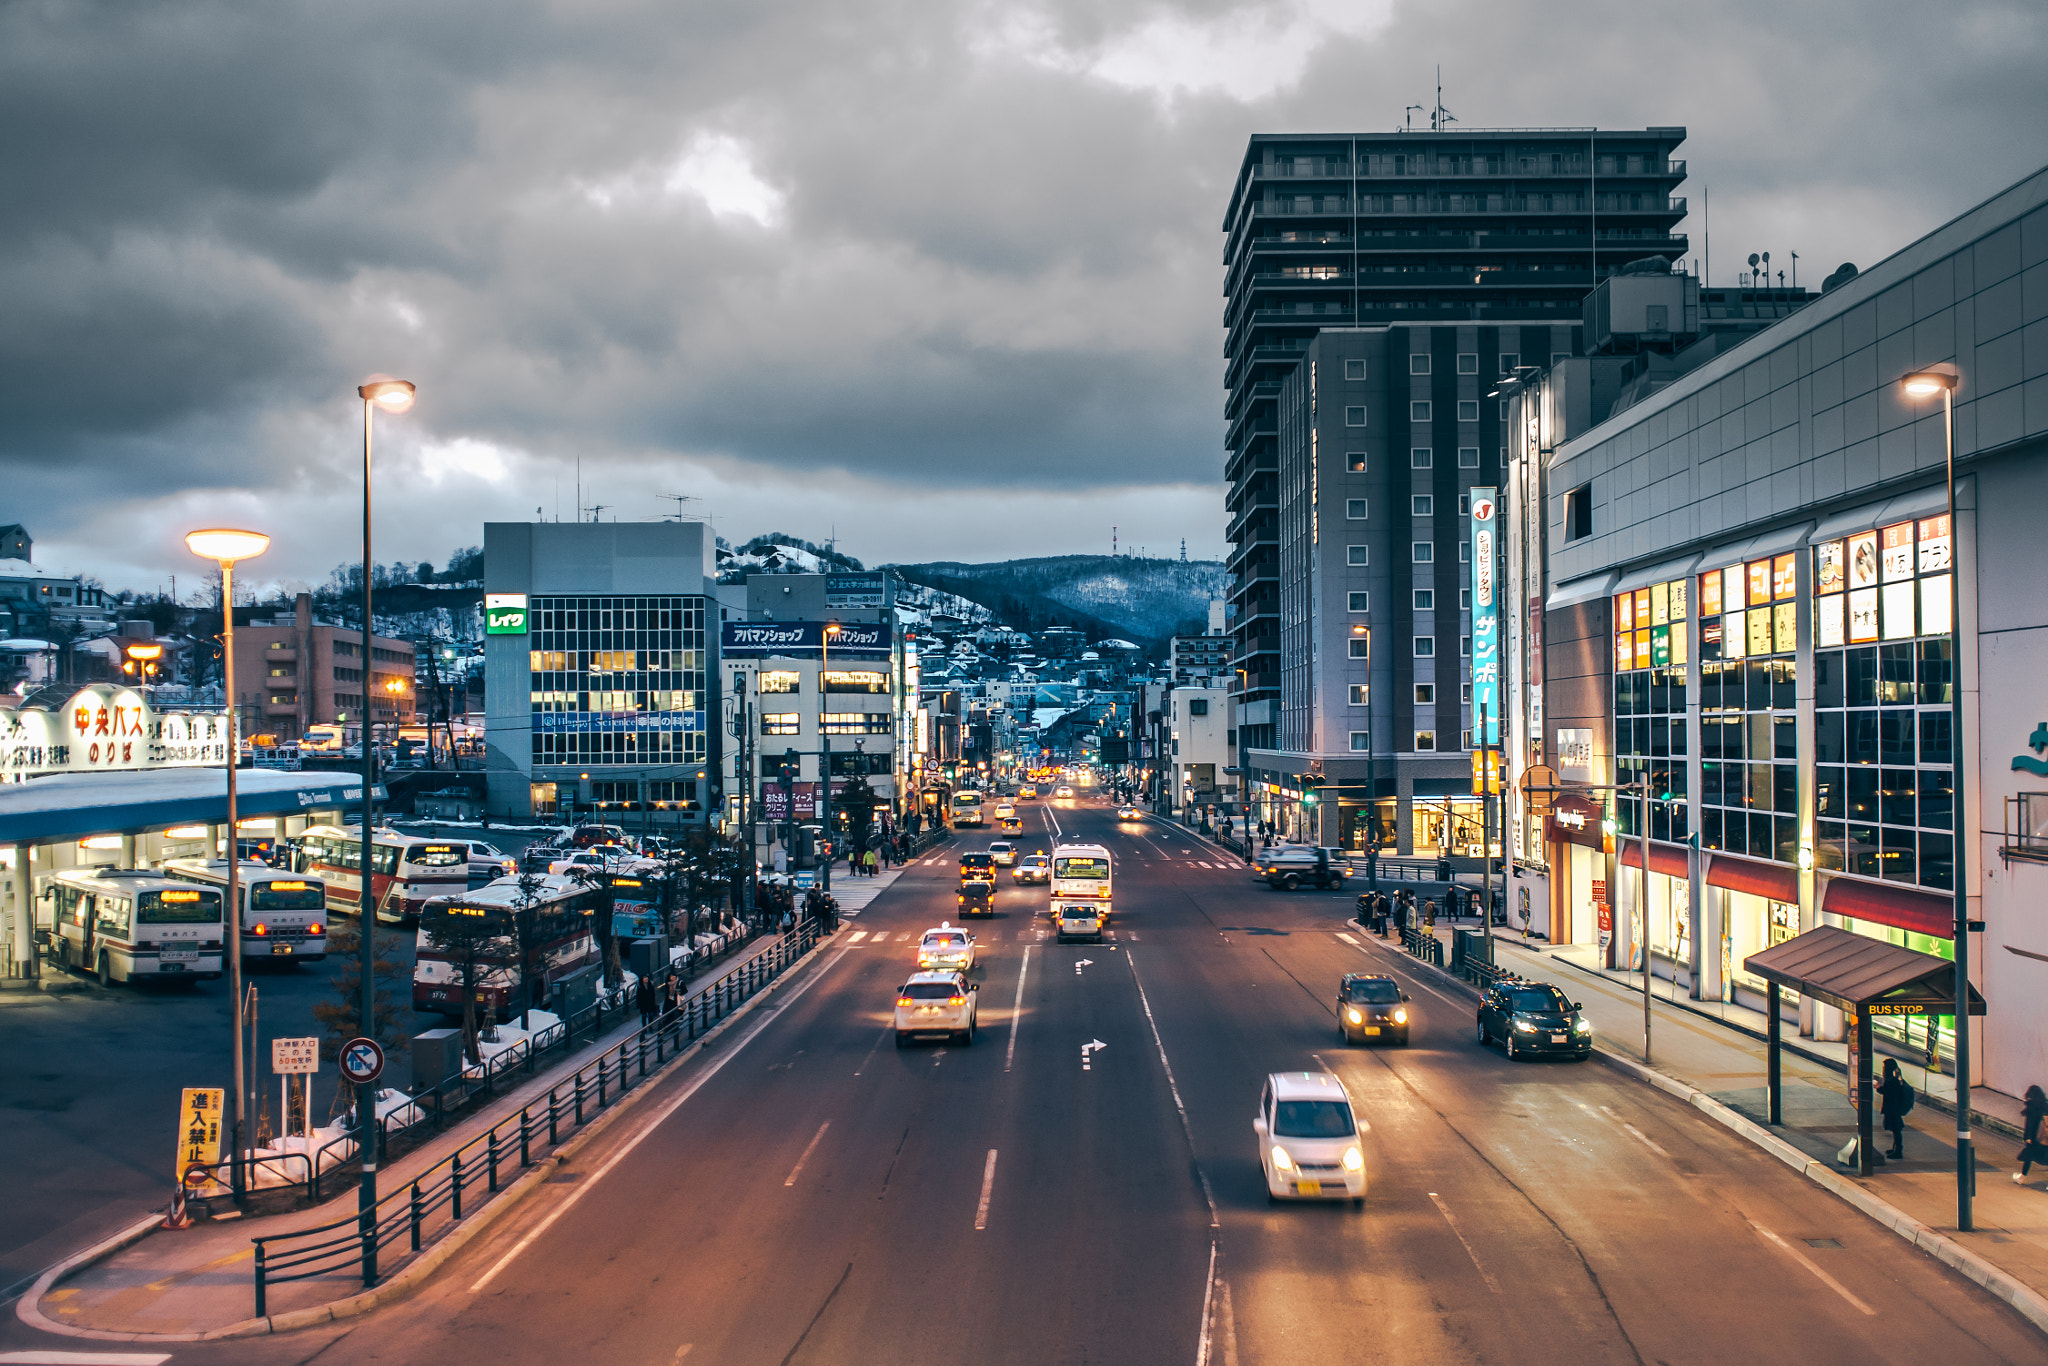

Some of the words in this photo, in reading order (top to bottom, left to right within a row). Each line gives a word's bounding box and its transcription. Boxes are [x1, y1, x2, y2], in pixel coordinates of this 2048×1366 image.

[1480, 536, 1489, 602] ショッピングタウン
[490, 614, 523, 627] レイク
[734, 628, 804, 642] アパマンショップ
[75, 704, 143, 737] 中央バス
[595, 717, 636, 727] Science
[637, 716, 694, 727] 幸福の科学
[89, 742, 132, 763] のりば
[766, 804, 788, 812] クリニッ
[1869, 1005, 1892, 1014] BUS
[1893, 1005, 1924, 1014] STOP
[276, 1040, 316, 1048] 小樽駅入口
[187, 1093, 208, 1162] 進入禁止
